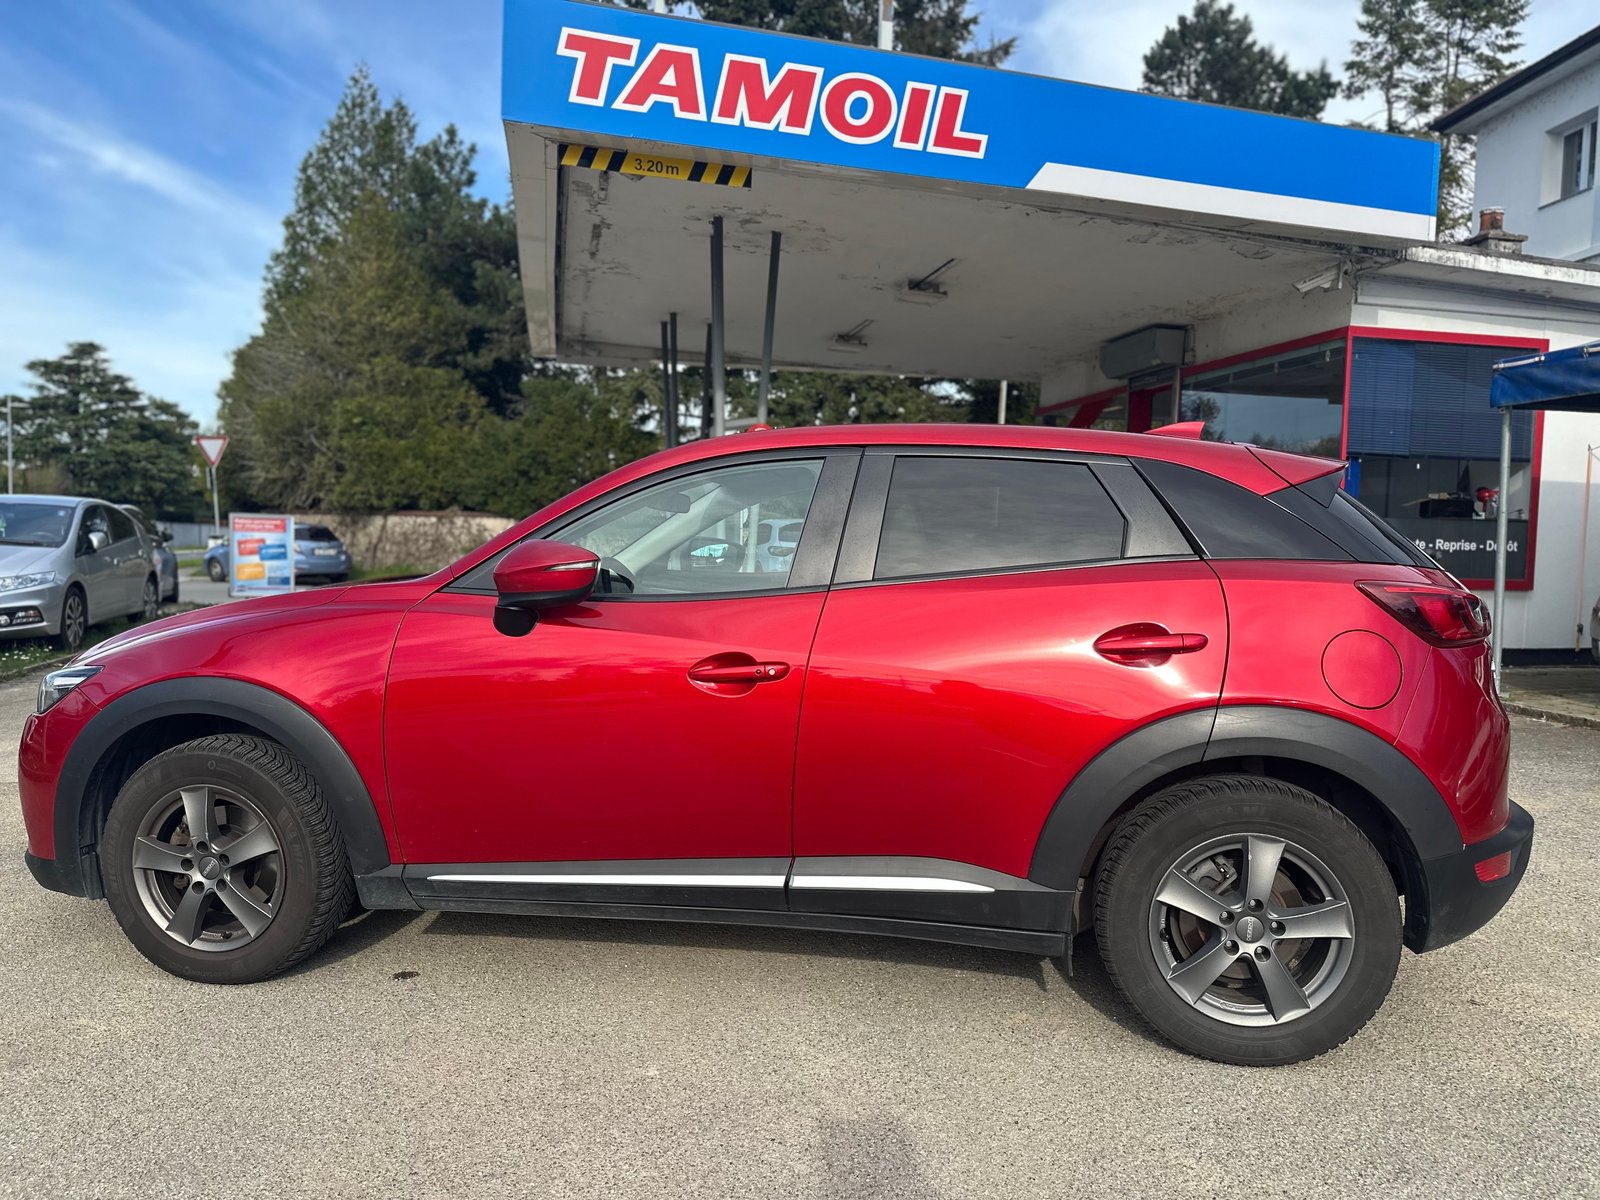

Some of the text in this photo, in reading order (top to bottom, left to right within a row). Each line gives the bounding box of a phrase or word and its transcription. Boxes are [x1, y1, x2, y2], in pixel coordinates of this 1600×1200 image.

[557, 27, 988, 159] TAMOIL
[634, 158, 679, 175] 3.20 m
[1435, 539, 1477, 553] Reprise
[1486, 540, 1518, 552] Dôt
